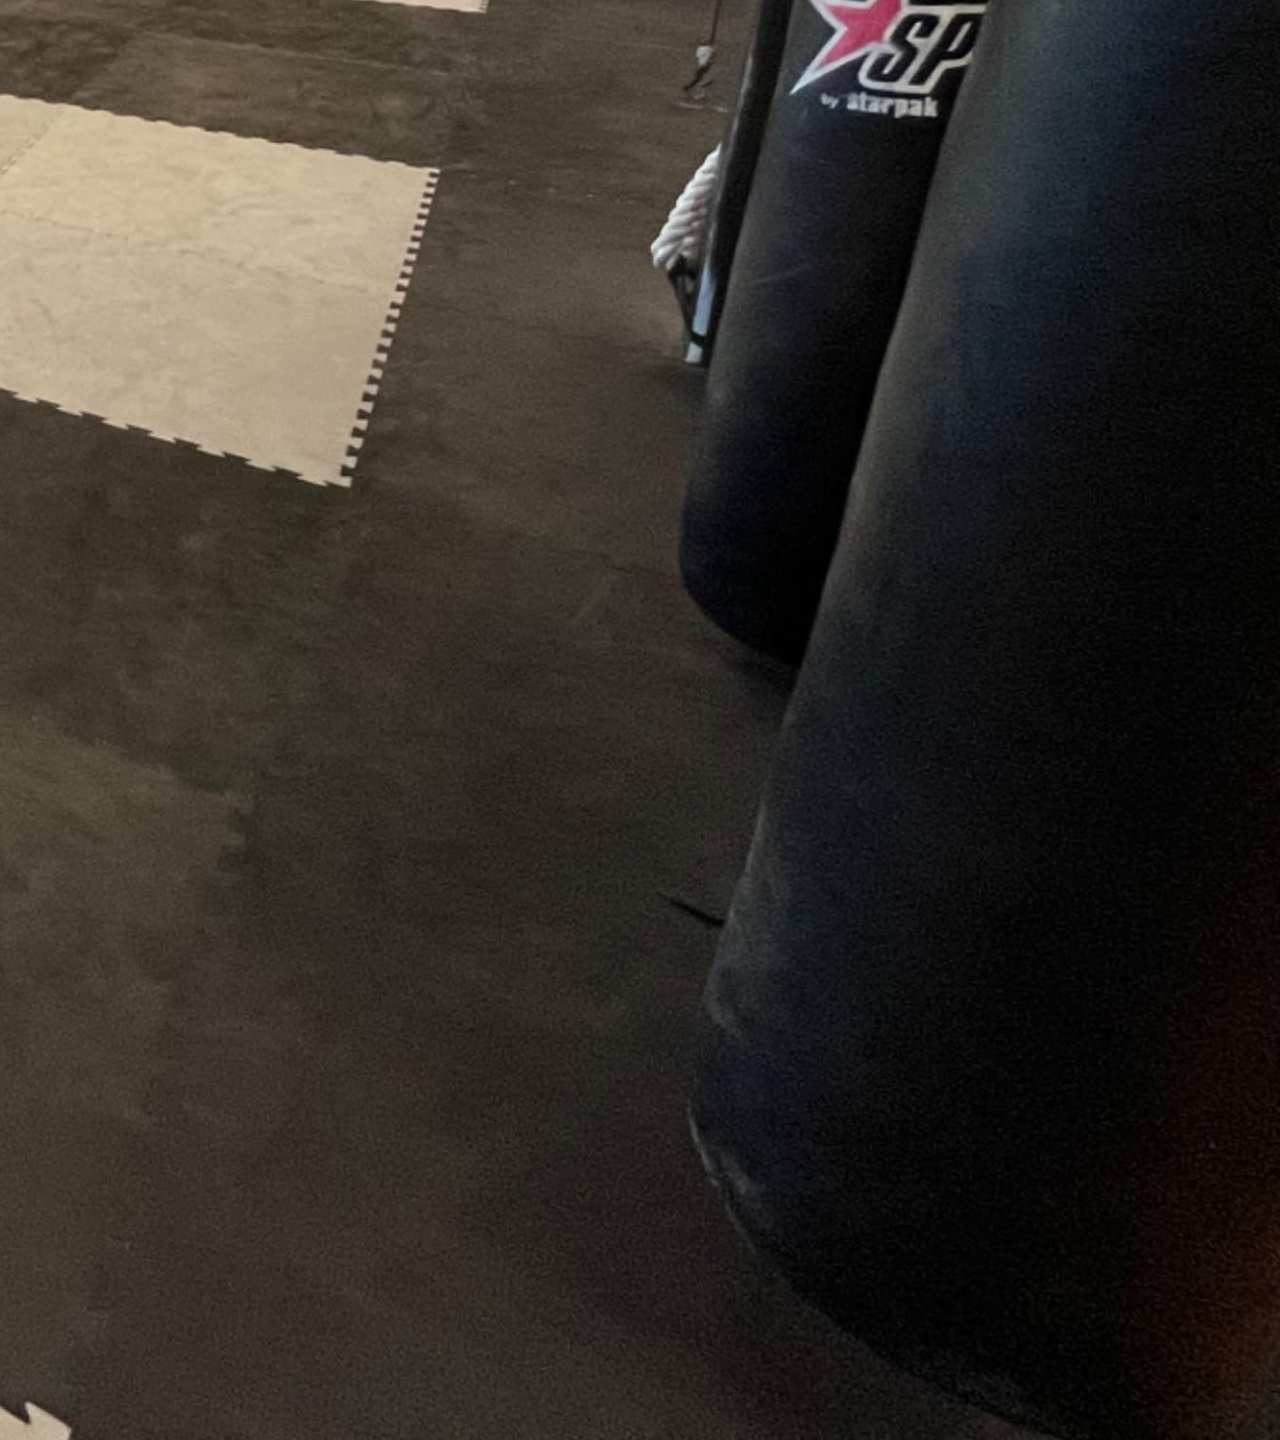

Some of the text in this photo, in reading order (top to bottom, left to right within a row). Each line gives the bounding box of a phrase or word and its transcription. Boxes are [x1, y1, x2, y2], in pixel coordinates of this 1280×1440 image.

[863, 9, 985, 88] SP
[820, 91, 939, 119] by starpak
